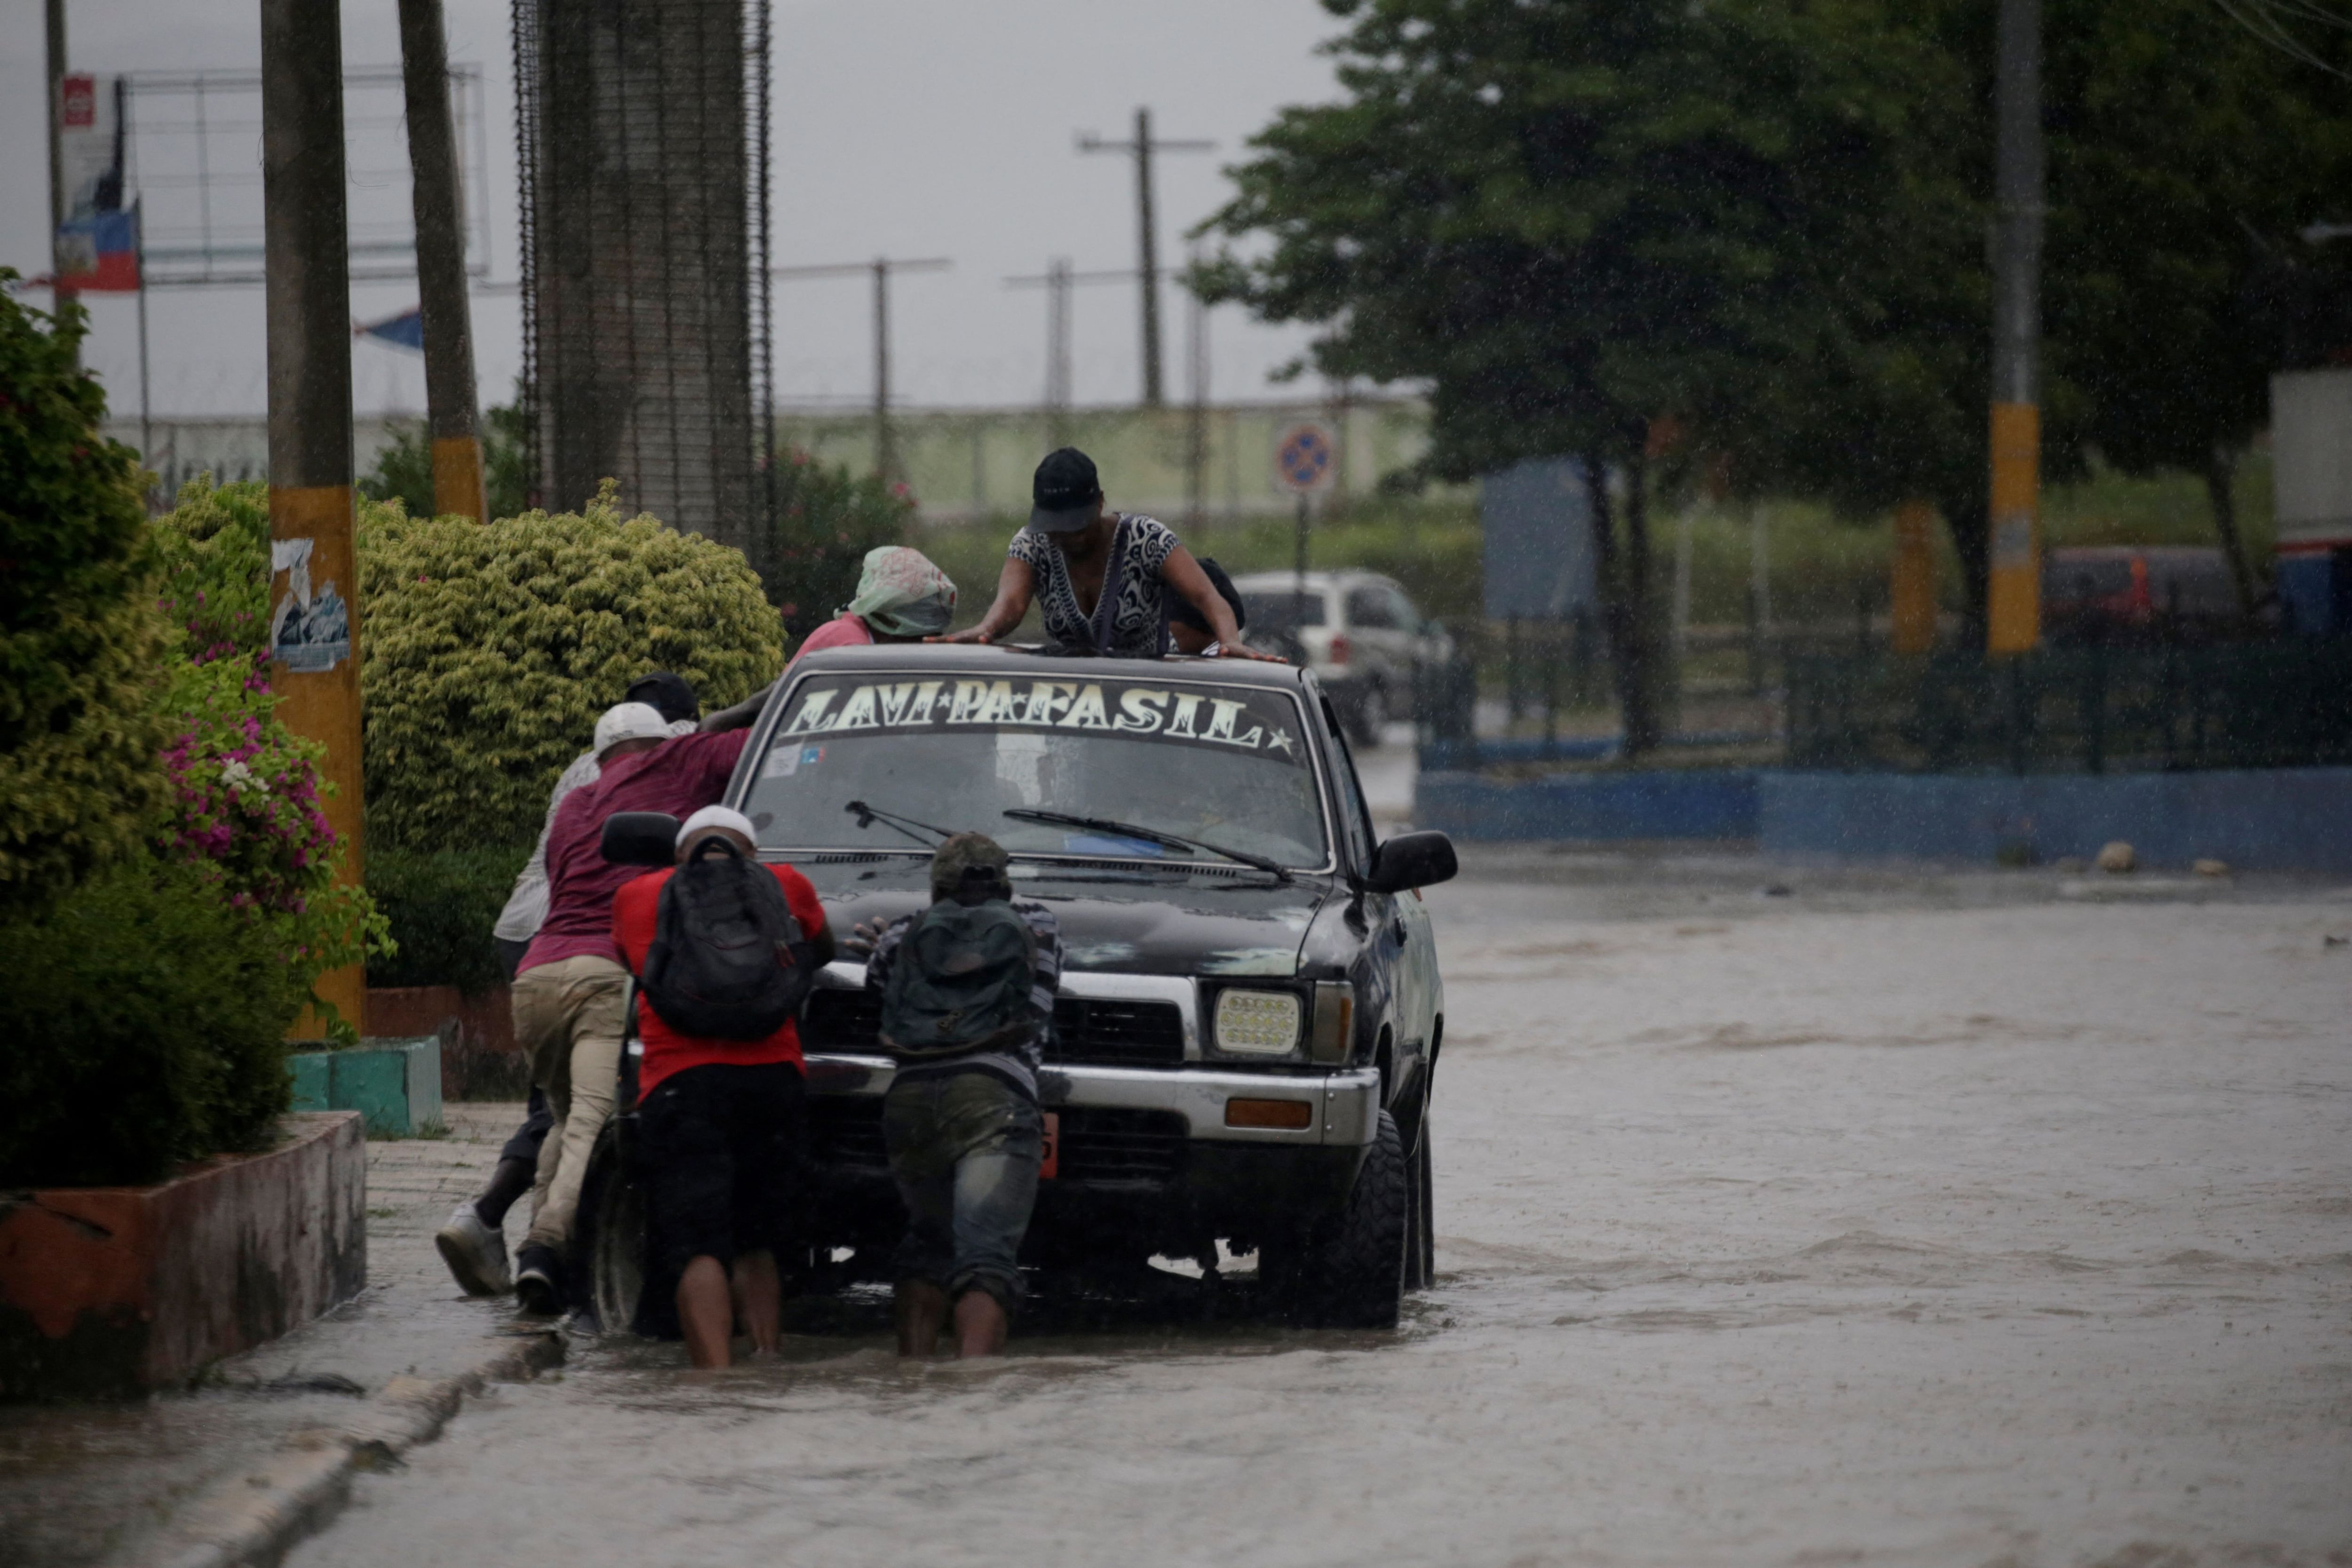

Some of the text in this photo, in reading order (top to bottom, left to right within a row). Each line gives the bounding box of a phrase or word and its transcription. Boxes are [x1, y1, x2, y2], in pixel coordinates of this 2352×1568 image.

[780, 680, 1263, 748] LAVI PA FASIL
